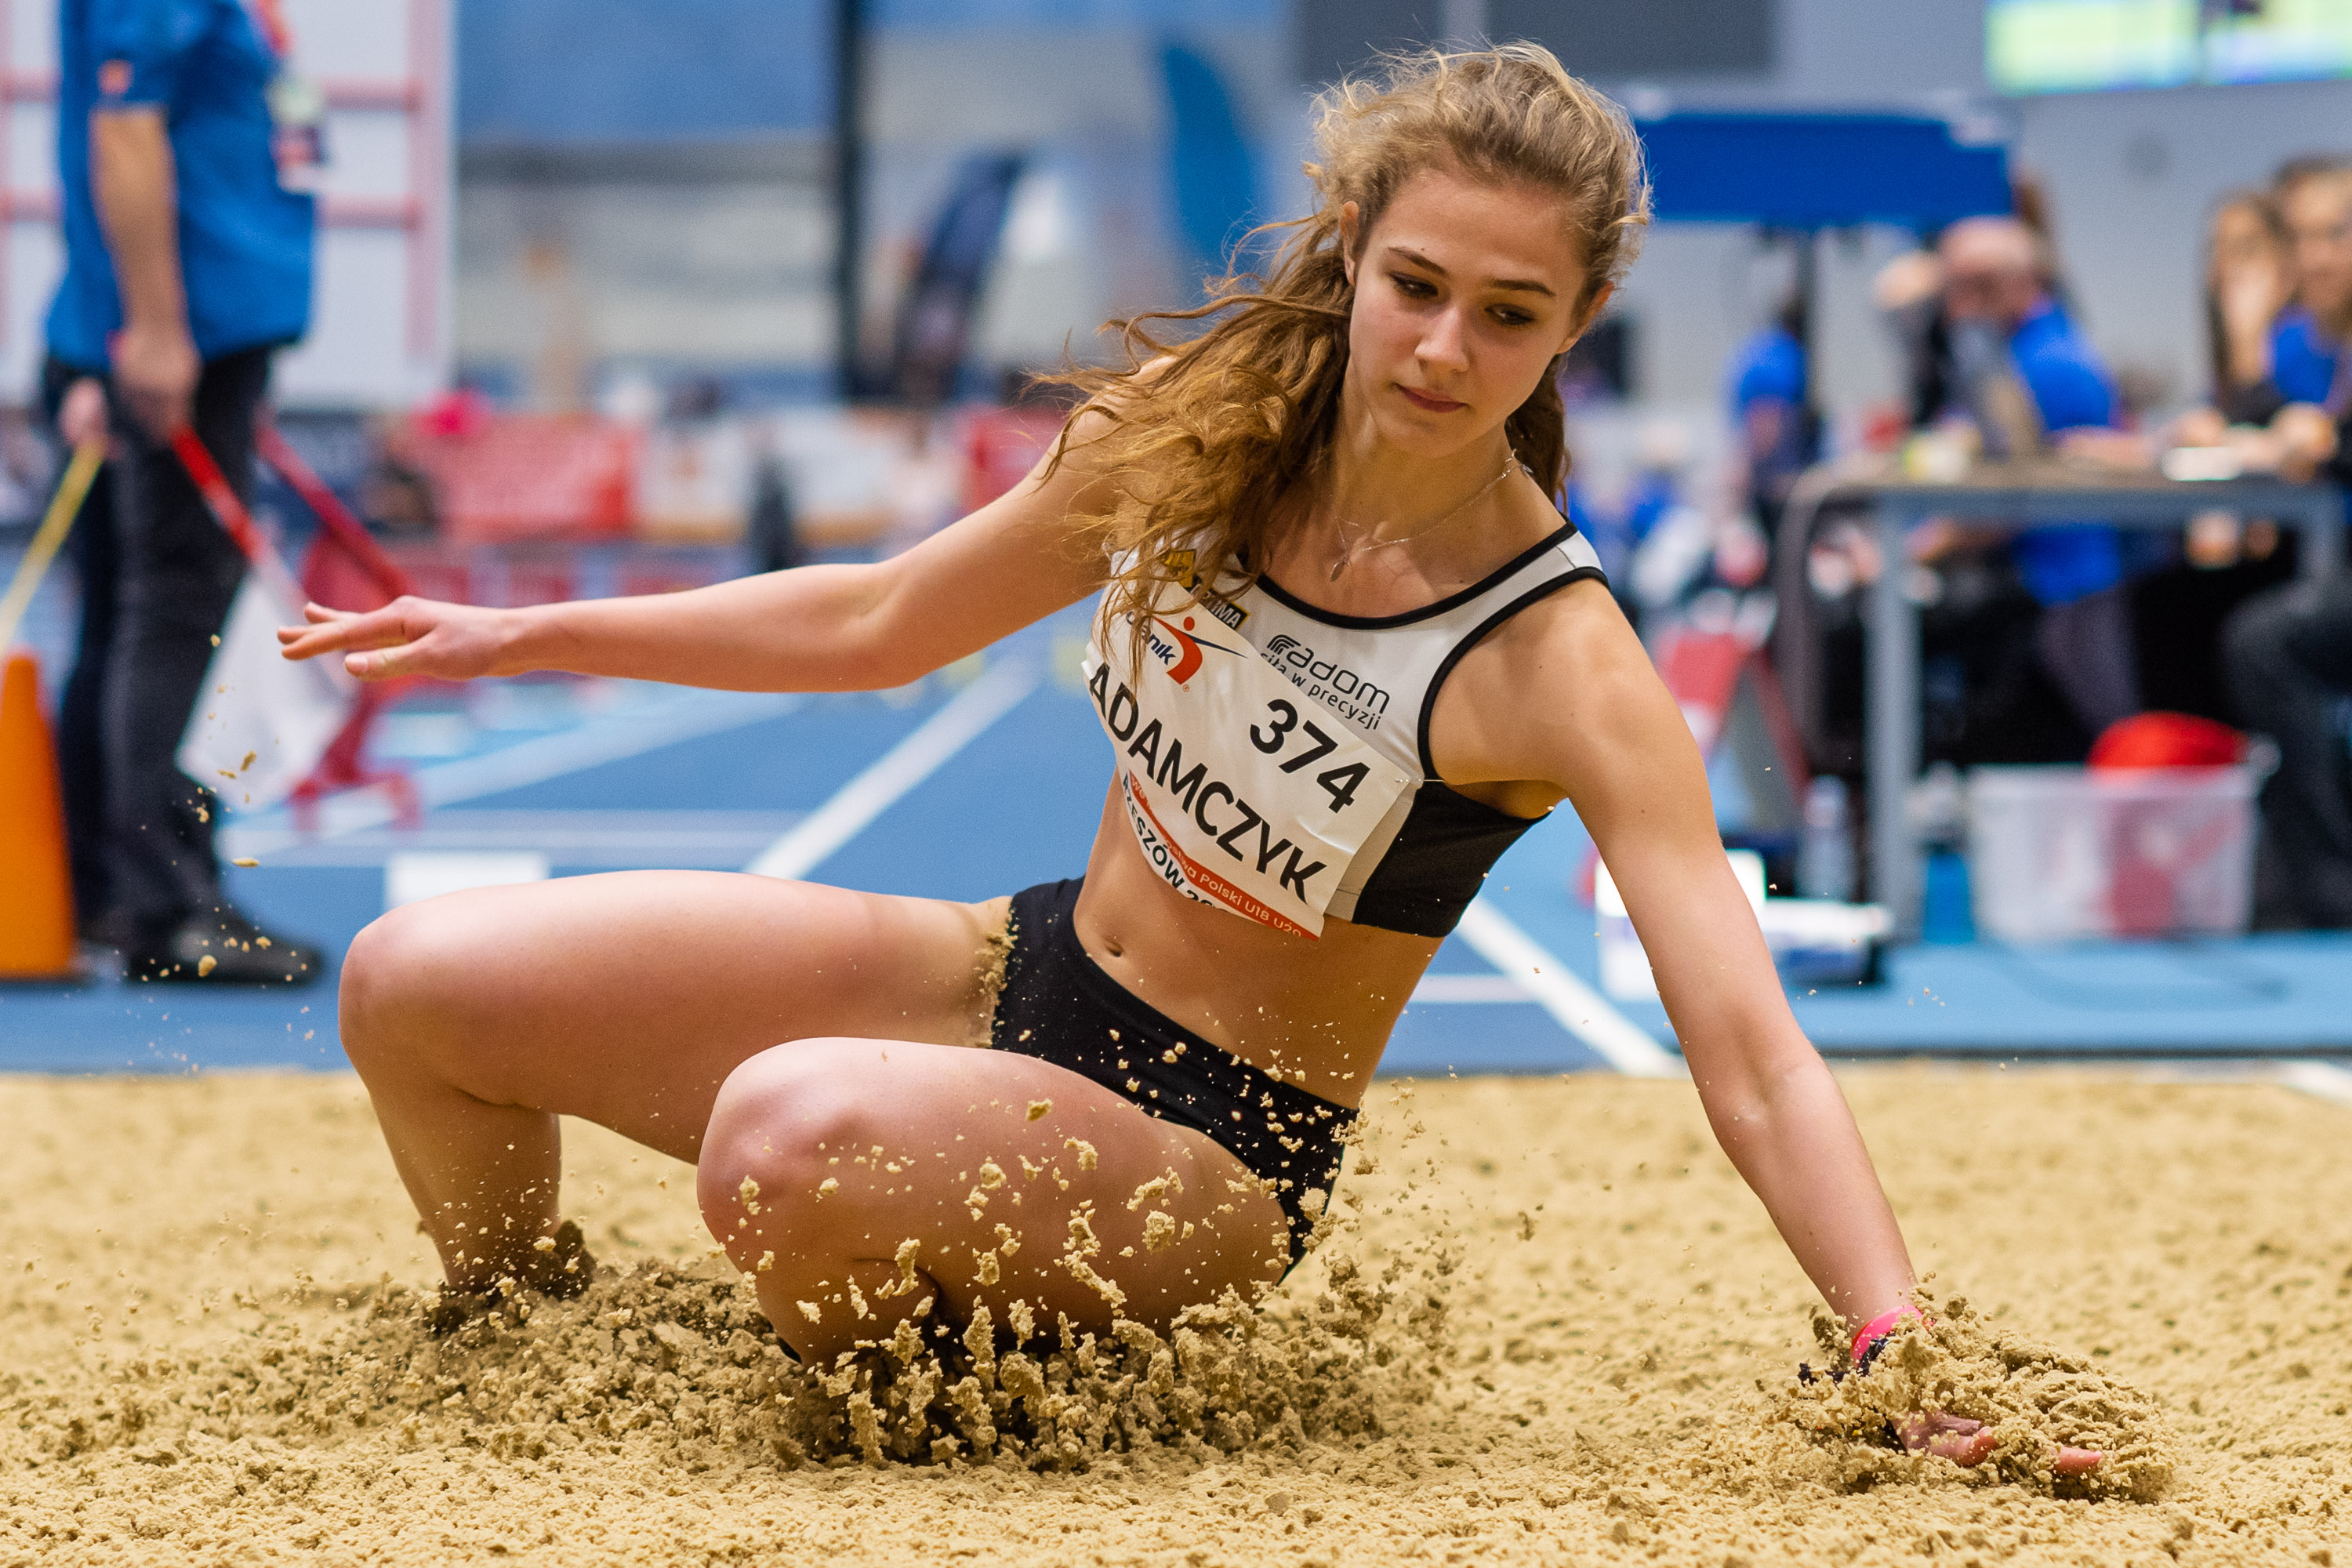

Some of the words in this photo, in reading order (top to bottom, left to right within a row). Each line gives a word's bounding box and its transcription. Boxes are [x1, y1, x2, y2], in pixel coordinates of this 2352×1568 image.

[1266, 634, 1390, 714] radom
[1291, 673, 1307, 687] w
[1307, 684, 1381, 731] precyzji
[1089, 662, 1327, 905] ADAMCZYK
[1250, 699, 1371, 814] 374
[1199, 873, 1243, 907] Polski
[1245, 902, 1270, 921] U18
